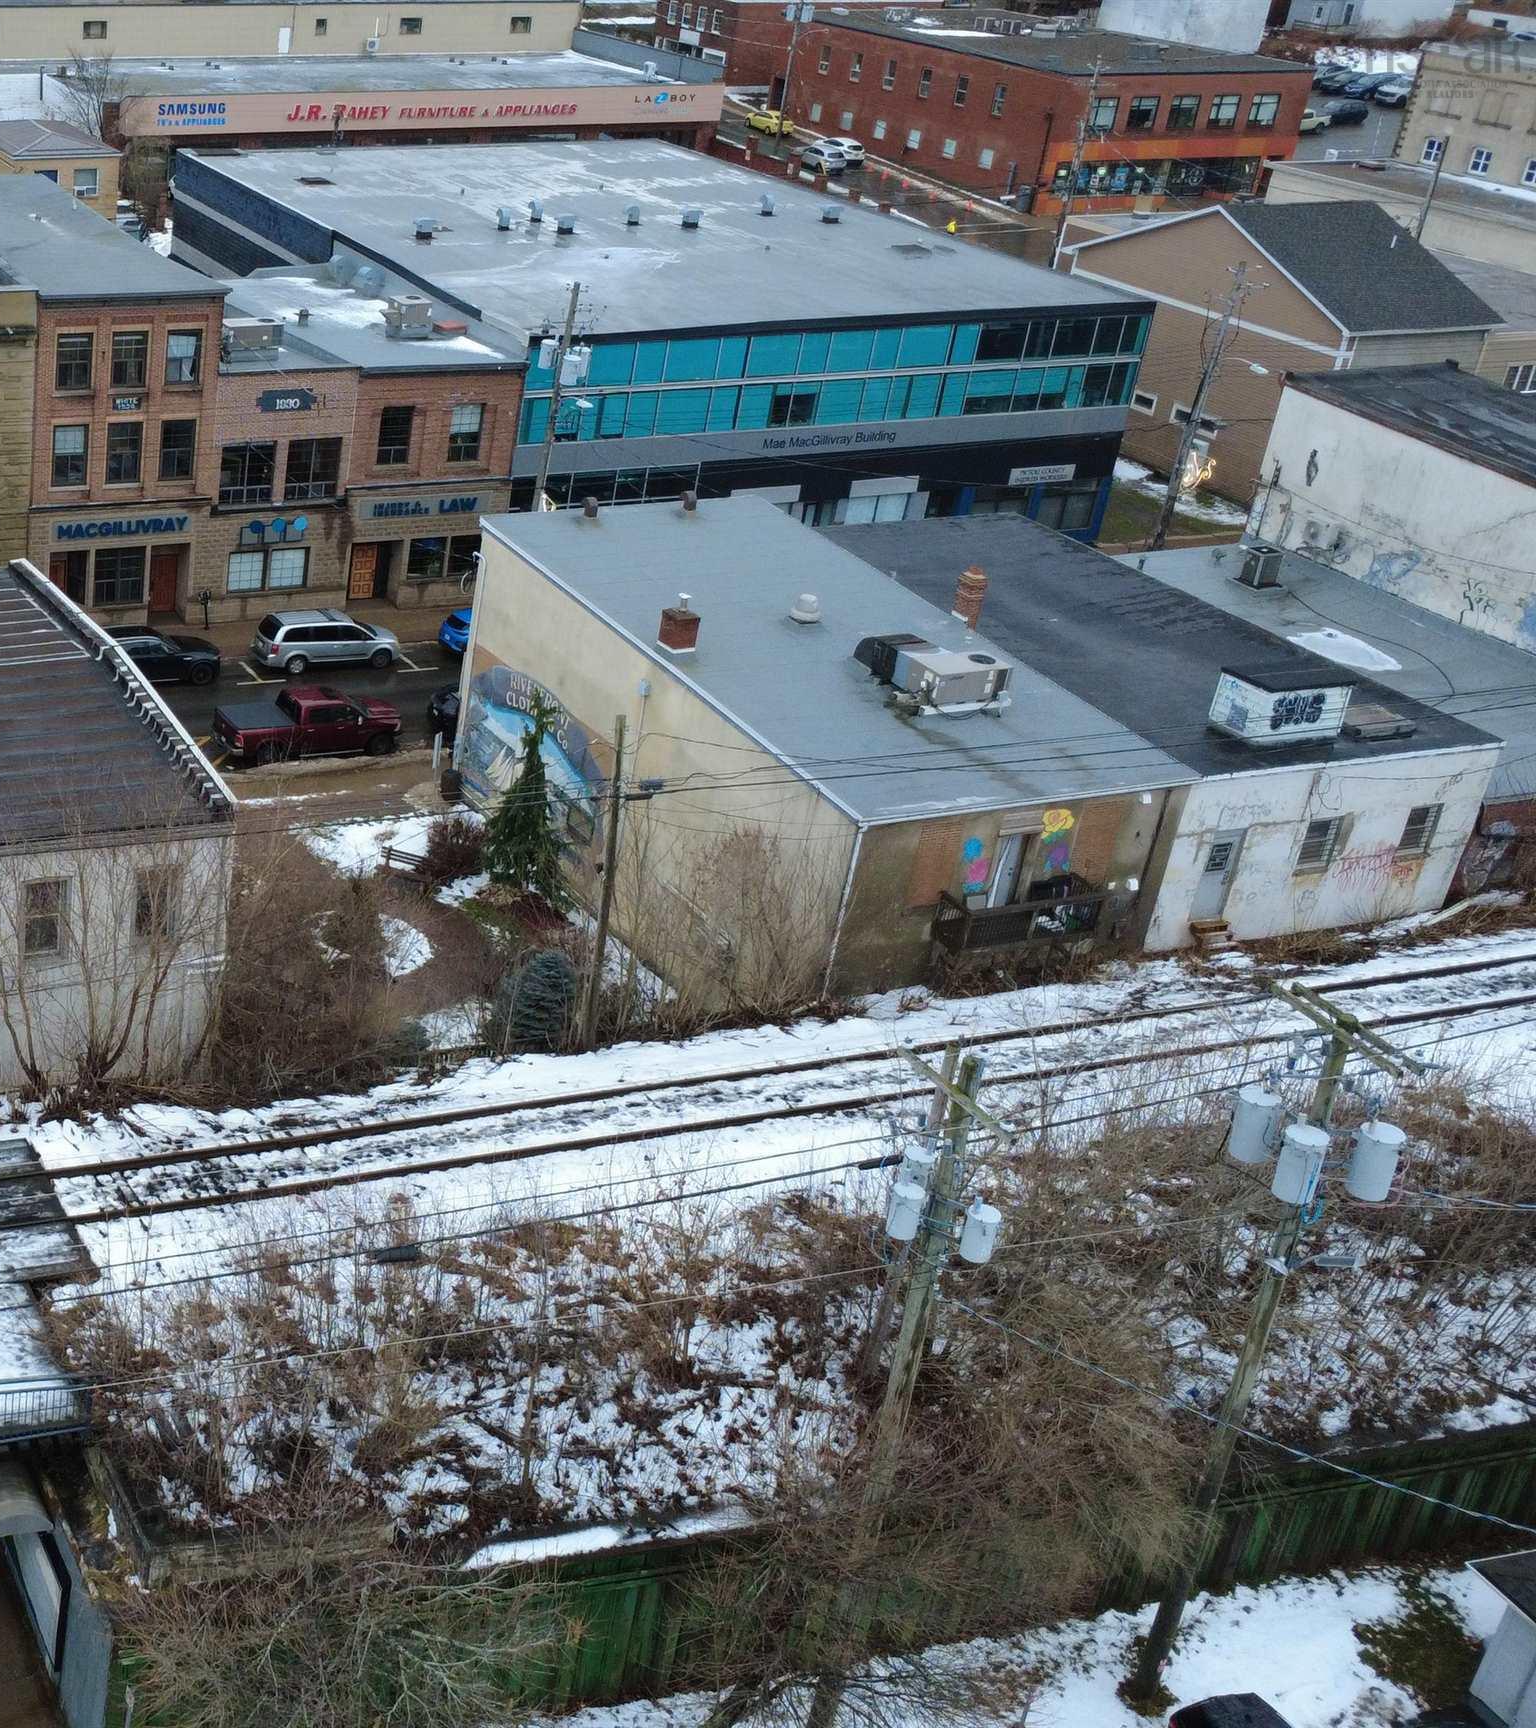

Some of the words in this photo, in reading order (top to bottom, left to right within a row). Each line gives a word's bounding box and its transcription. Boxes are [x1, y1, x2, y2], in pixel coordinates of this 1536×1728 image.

[158, 103, 226, 116] SAMSUNG
[287, 105, 327, 121] J.R.
[399, 106, 476, 119] FURNITURE
[494, 104, 578, 118] APPLIANCES
[763, 438, 785, 449] Mae
[789, 434, 852, 448] MacGillivray
[855, 431, 897, 443] Building
[439, 497, 479, 513] LAW
[57, 516, 188, 539] MACGILLIVRAY
